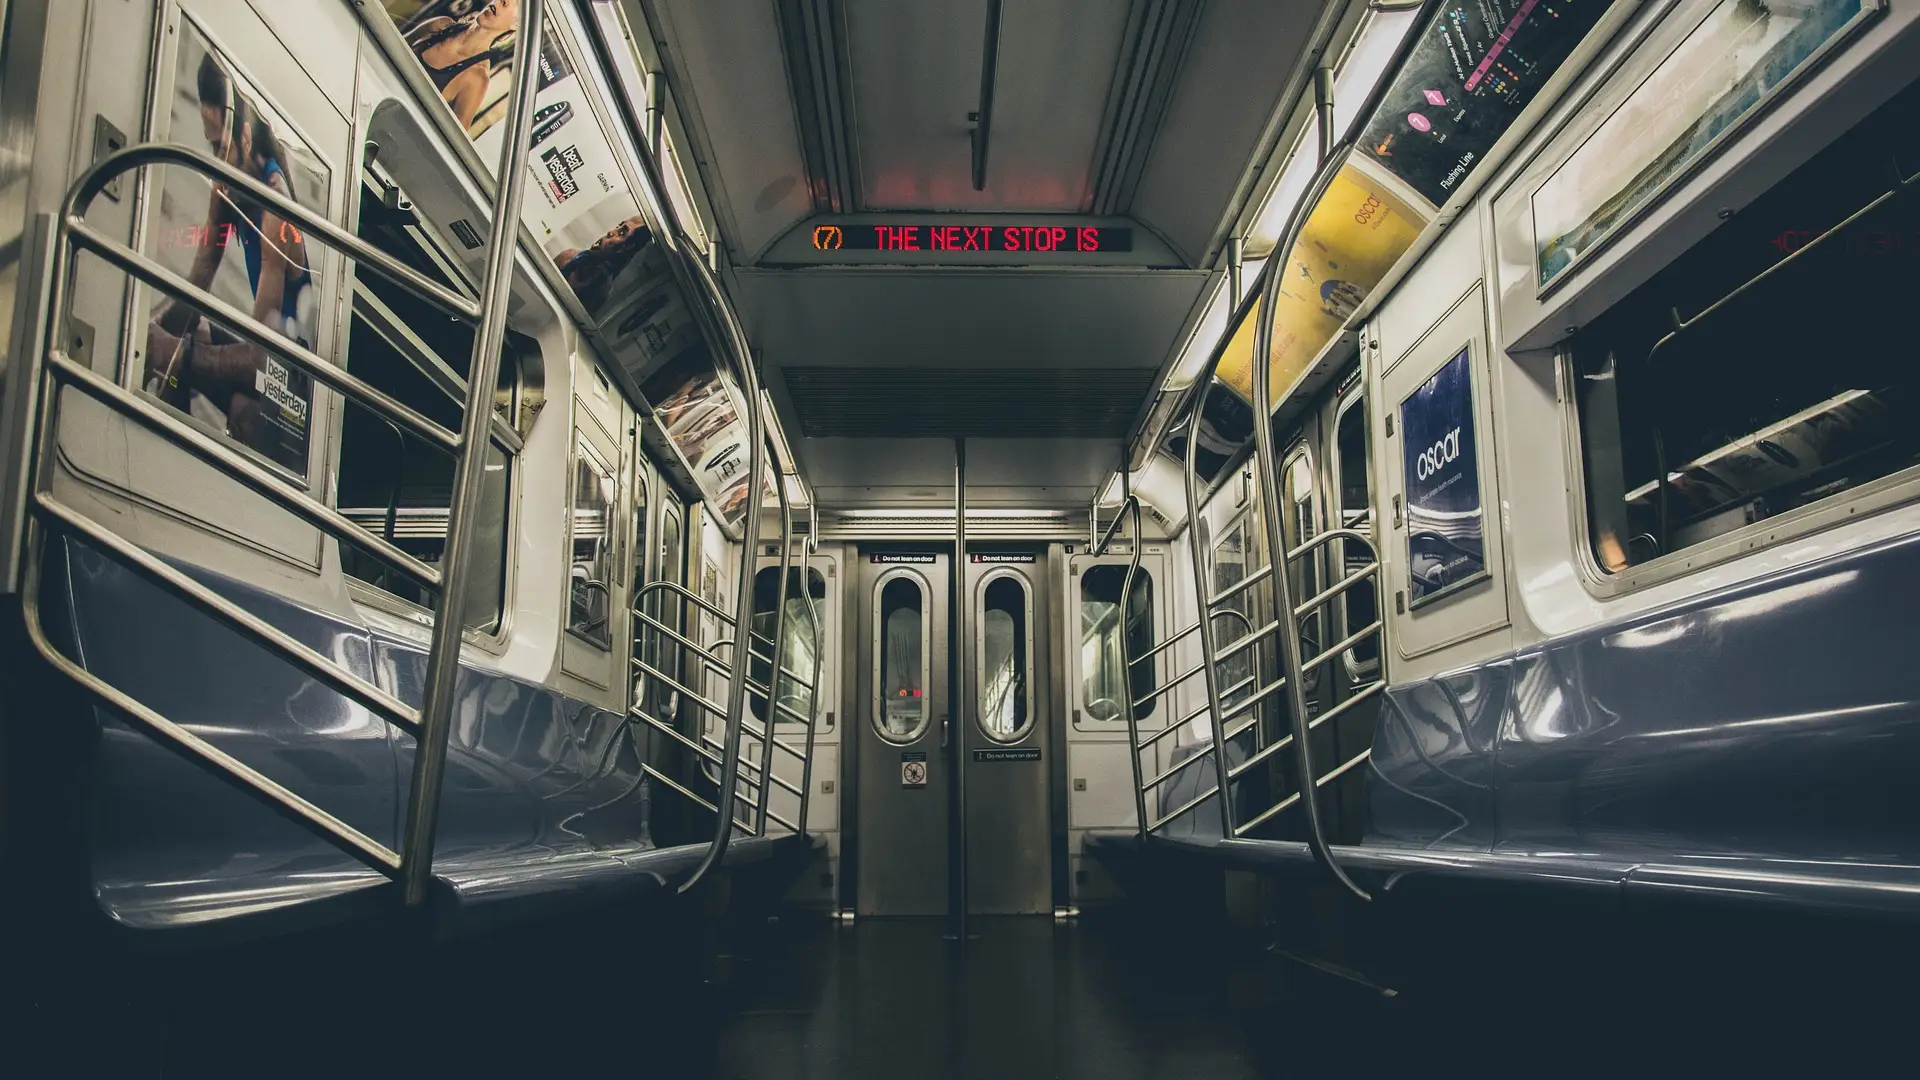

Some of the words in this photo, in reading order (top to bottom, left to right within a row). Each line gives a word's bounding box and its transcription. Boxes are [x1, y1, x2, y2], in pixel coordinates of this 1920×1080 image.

[1485, 22, 1494, 38] Grand
[1438, 133, 1447, 144] Local
[562, 147, 583, 171] beat
[1440, 169, 1466, 190] Flushing
[1459, 151, 1475, 167] Line
[545, 154, 577, 198] yesterday.
[1354, 192, 1382, 225] oscar
[813, 225, 843, 249] (7)
[874, 226, 920, 251] THE
[930, 226, 993, 251] NEXT
[1004, 226, 1066, 251] STOP
[1077, 226, 1100, 251] IS
[267, 357, 288, 387] beat
[263, 377, 306, 417] yesterday.
[1417, 426, 1460, 481] oscar
